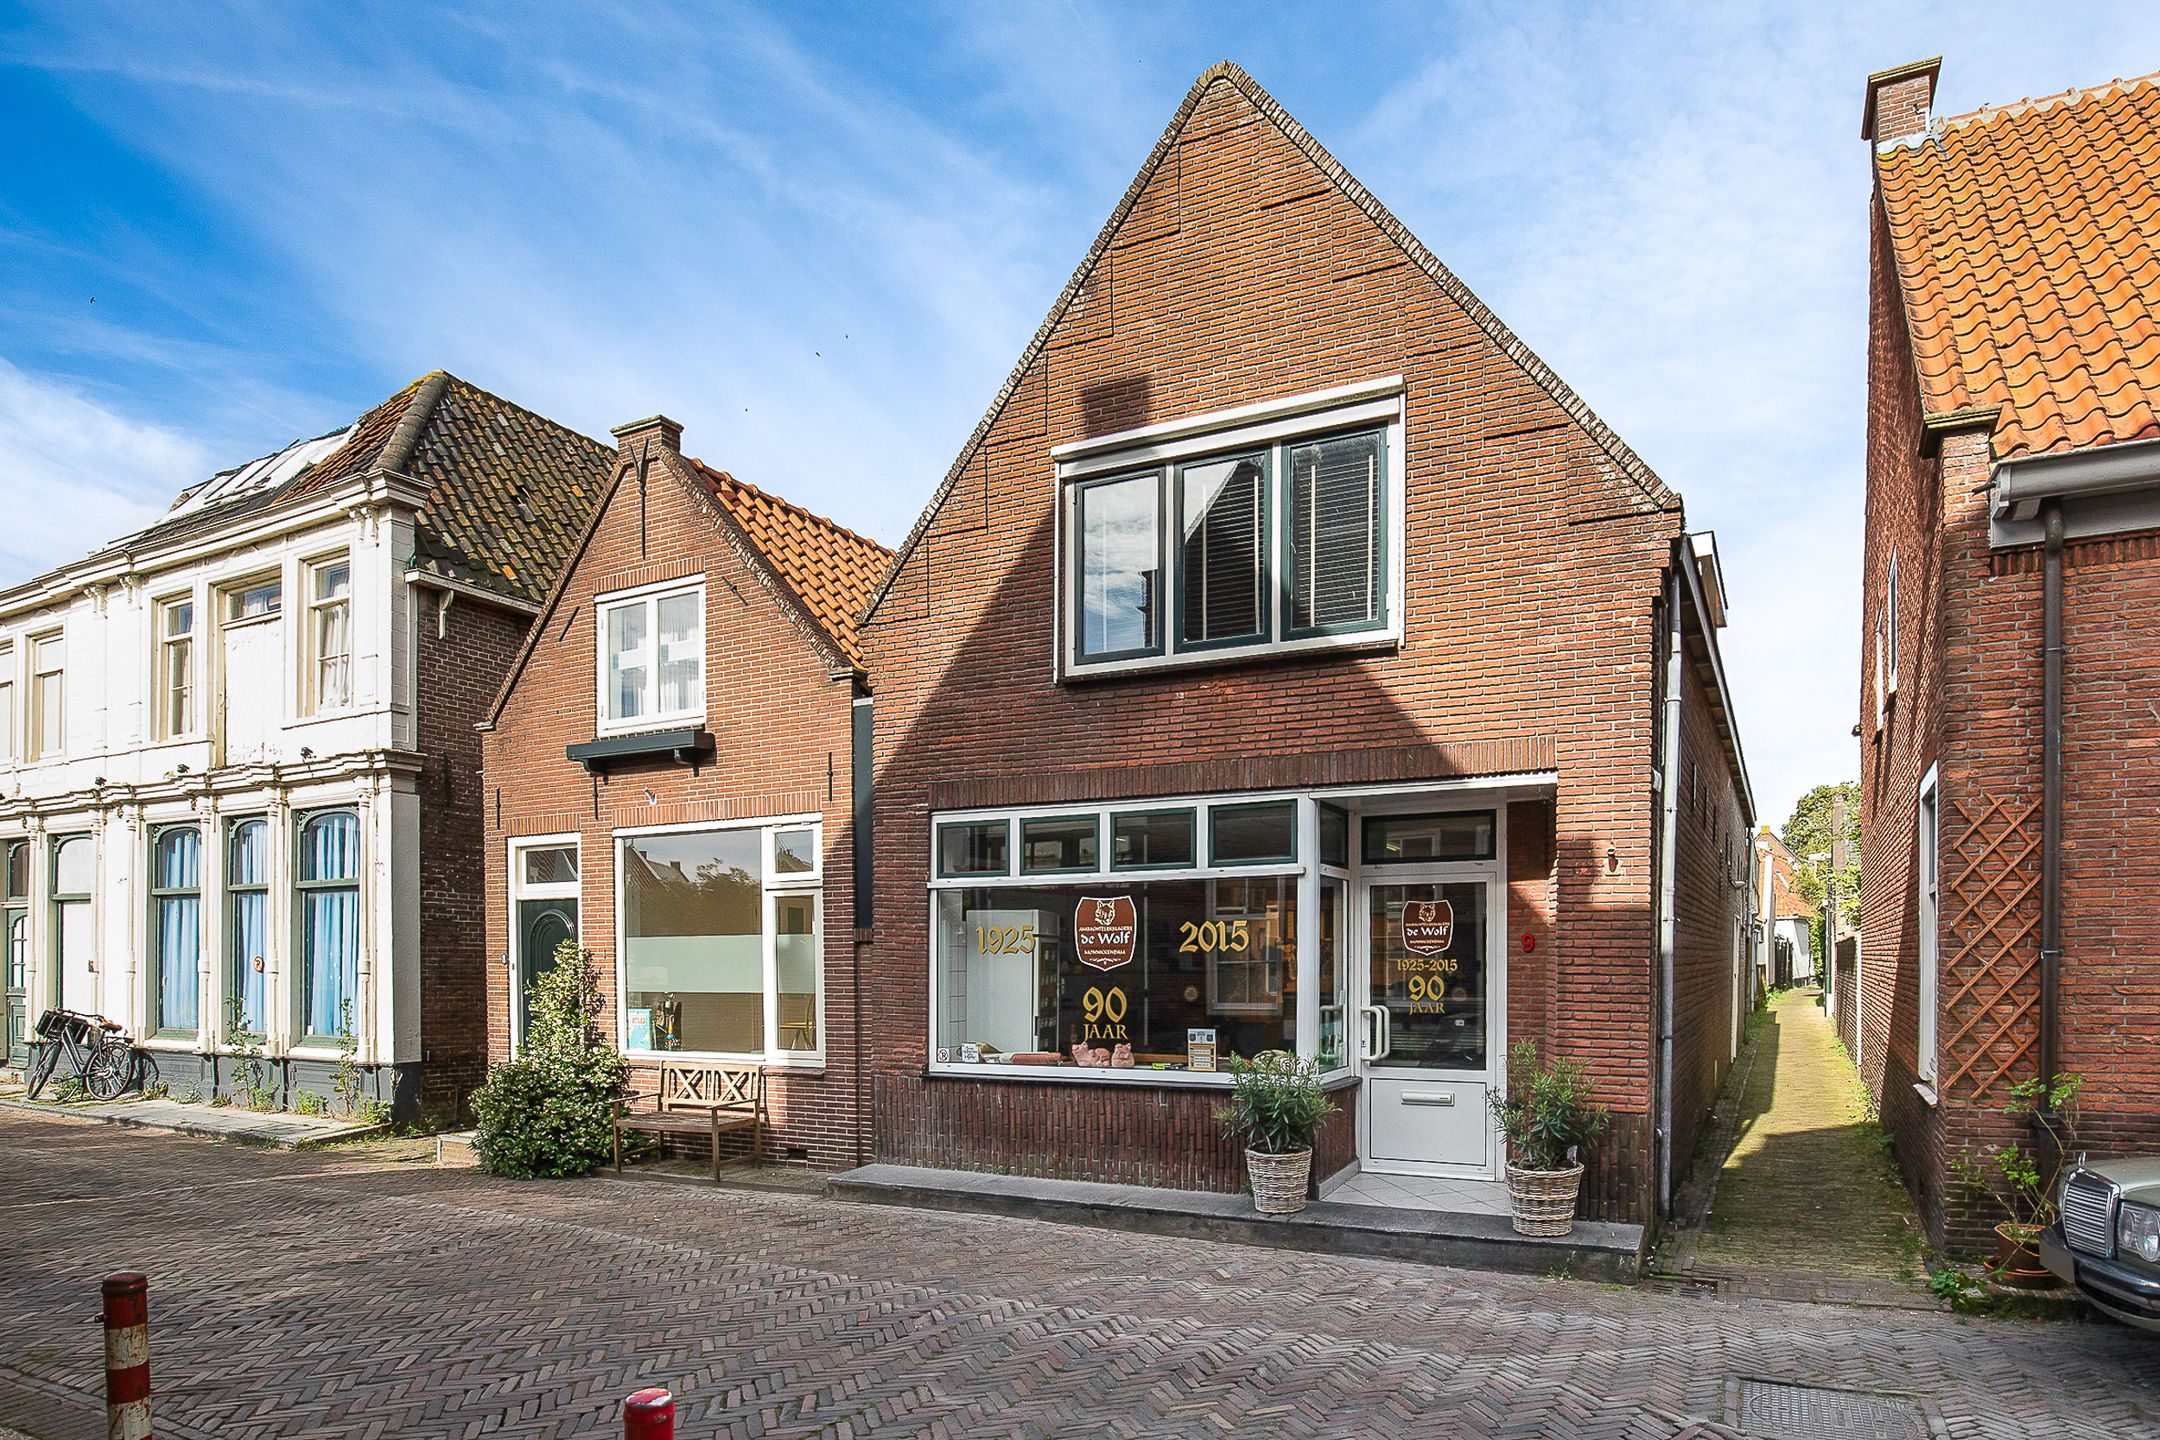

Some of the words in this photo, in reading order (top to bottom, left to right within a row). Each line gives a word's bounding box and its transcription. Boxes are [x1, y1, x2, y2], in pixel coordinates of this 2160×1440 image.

[976, 925, 1037, 955] 1925
[1081, 933, 1095, 945] de
[1097, 931, 1131, 945] Wolf
[1179, 921, 1249, 953] 2015
[1407, 927, 1419, 937] de
[1421, 925, 1449, 936] Wolf
[1521, 933, 1534, 952] 9
[1397, 958, 1458, 972] 1925-2015
[1409, 975, 1445, 1001] 90
[1083, 986, 1127, 1023] 90
[1409, 1002, 1446, 1016] JAAR
[1083, 1023, 1128, 1041] JAAR
